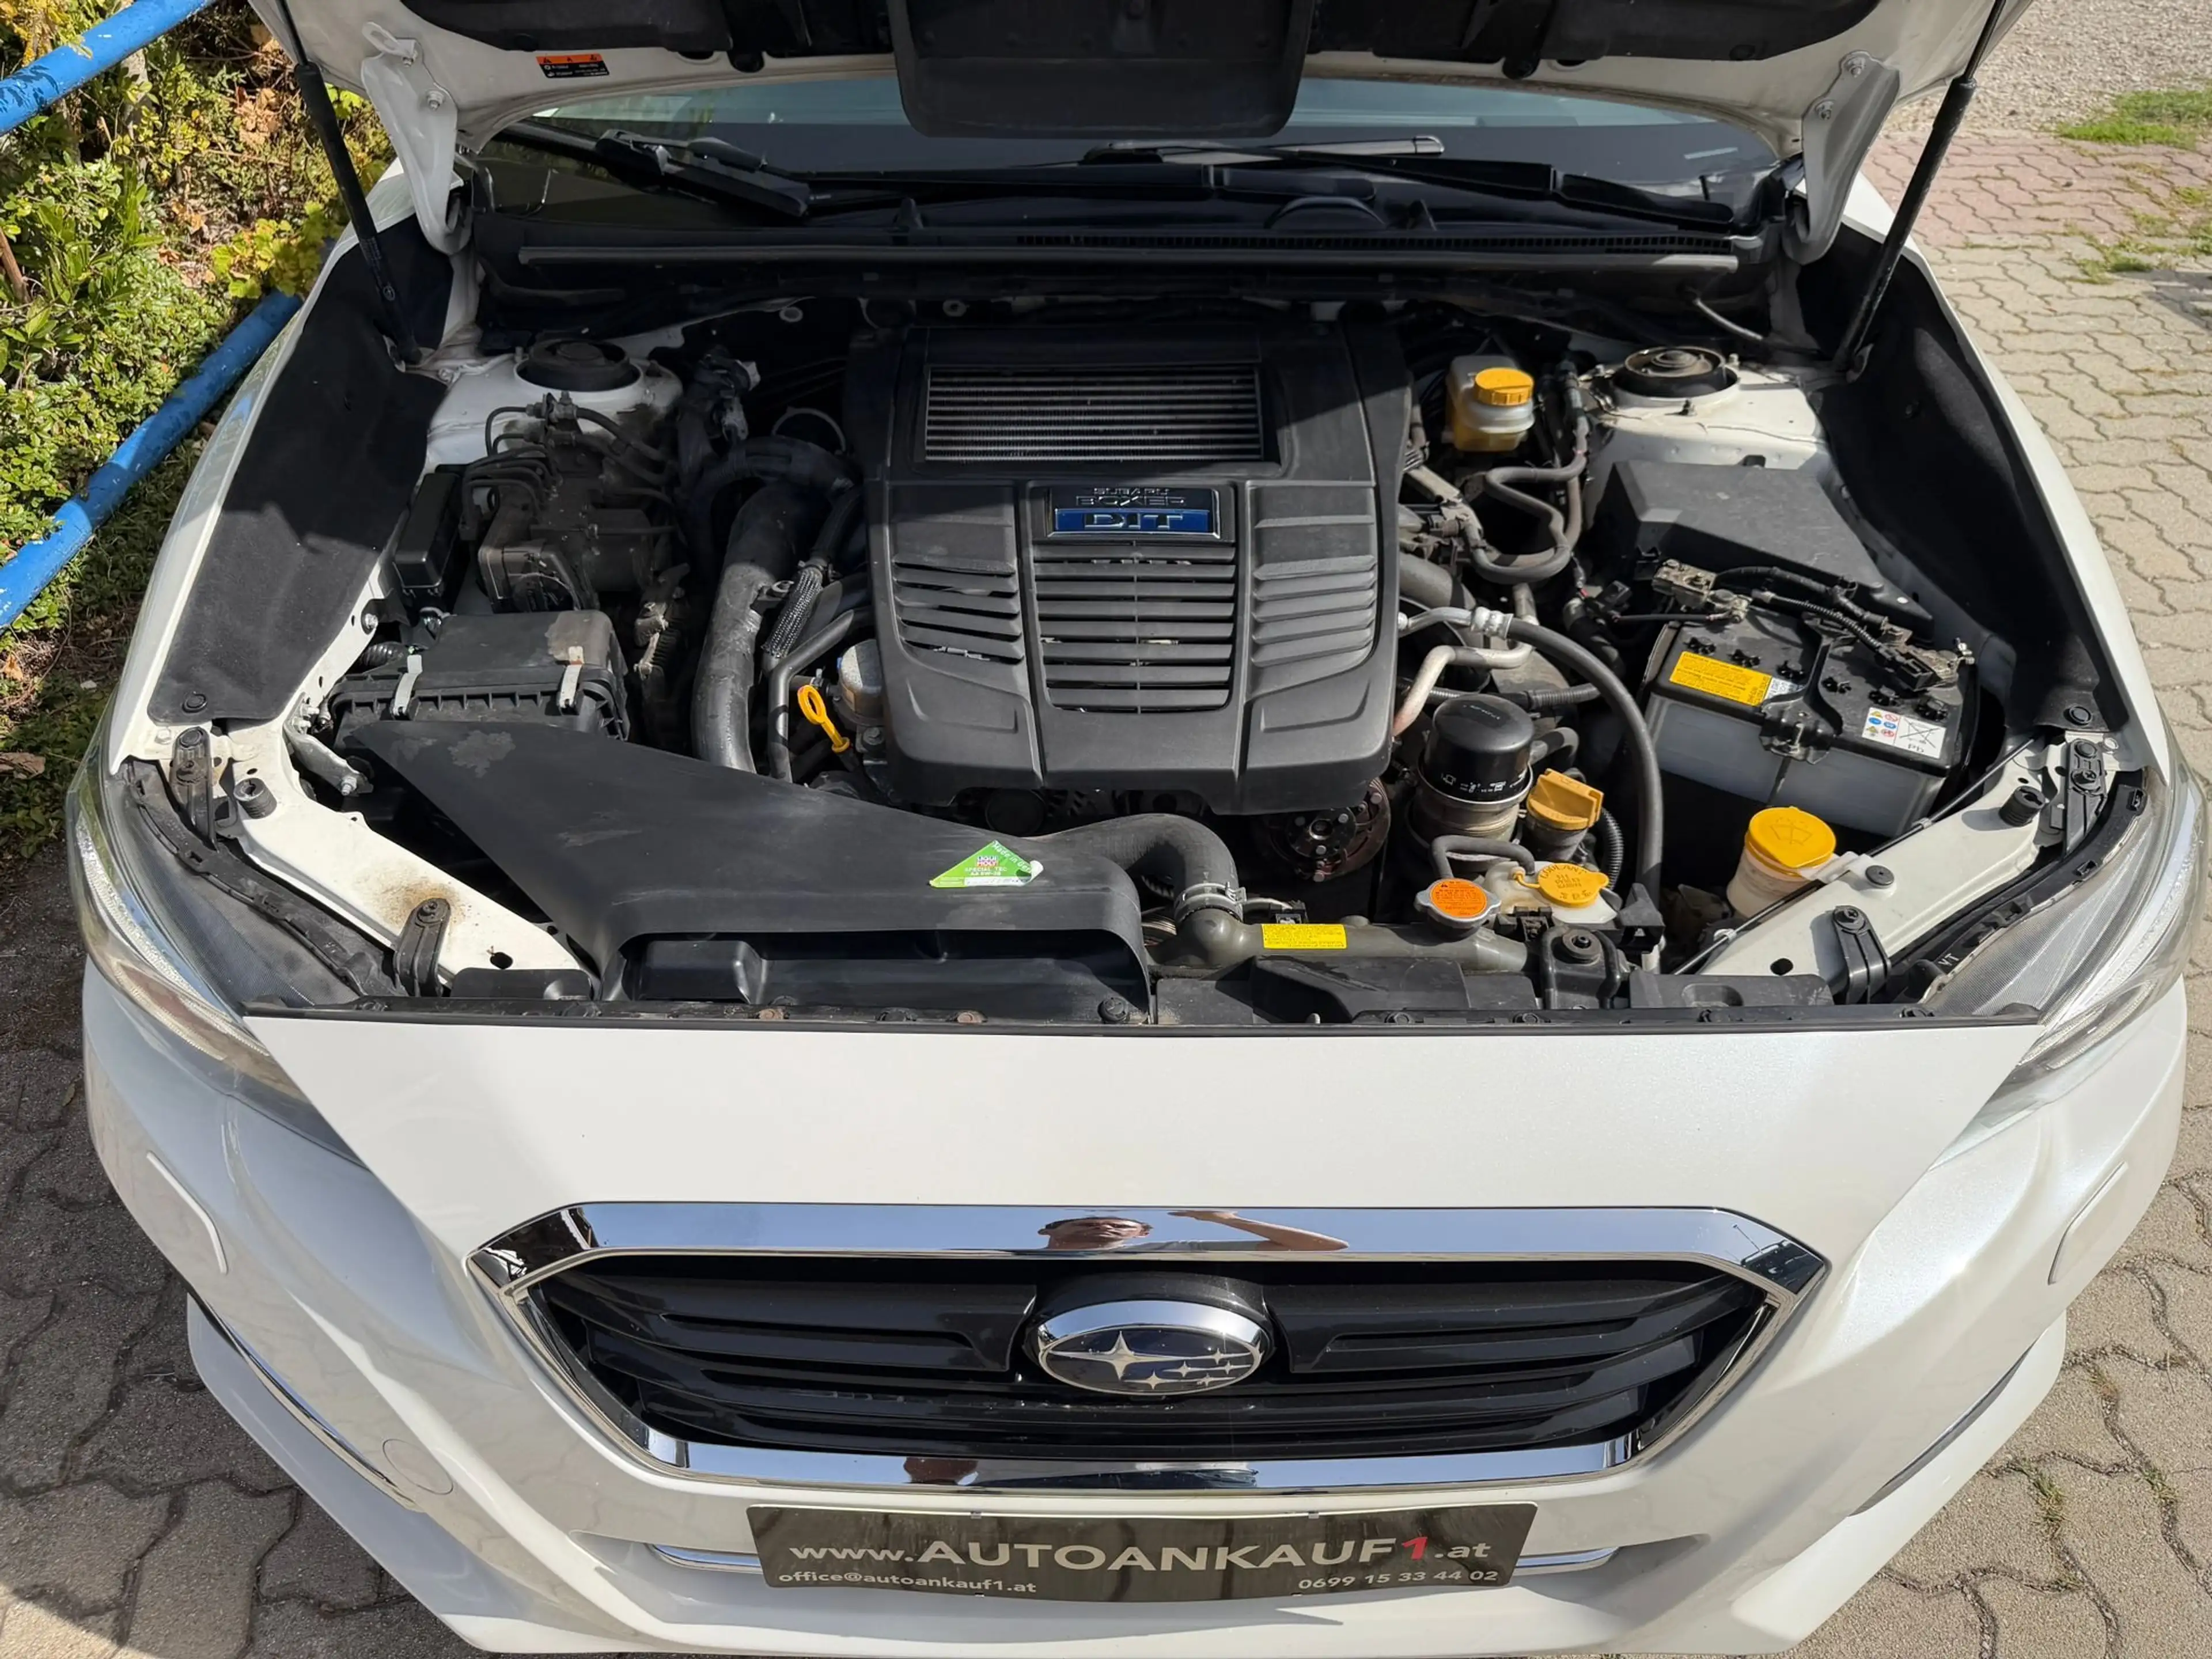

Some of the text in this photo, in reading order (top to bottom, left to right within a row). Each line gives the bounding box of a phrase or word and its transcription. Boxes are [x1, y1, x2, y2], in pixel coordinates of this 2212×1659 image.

[1075, 495, 1185, 506] BOXER
[1085, 513, 1183, 530] DIT
[778, 1571, 1037, 1593] office@autoankauf1.at
[1298, 1570, 1499, 1589] 0699 15 33 44 02
